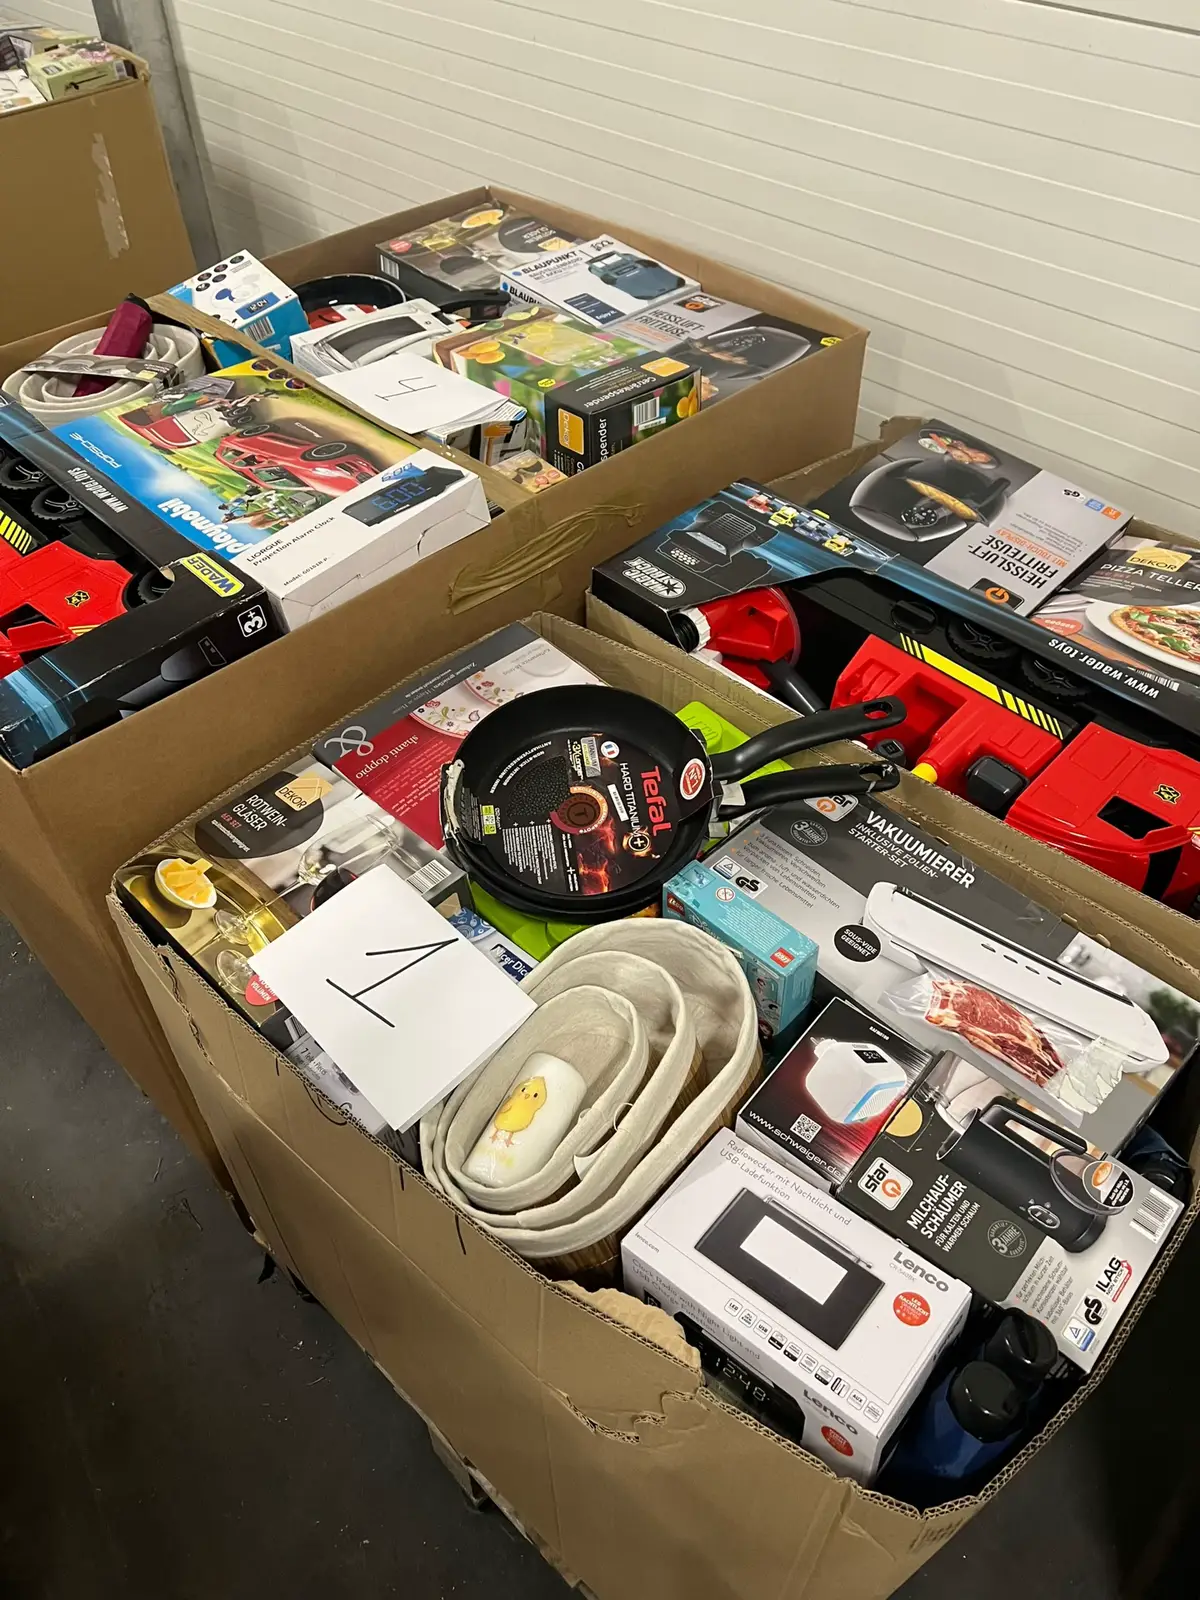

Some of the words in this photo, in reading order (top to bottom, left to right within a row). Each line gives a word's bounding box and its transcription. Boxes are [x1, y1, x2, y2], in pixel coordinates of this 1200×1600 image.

[522, 250, 578, 275] BLAUPUNKT
[634, 315, 691, 336] FRITTEUSE
[648, 309, 706, 332] HEISSLUFT-
[375, 376, 437, 401] 4
[69, 431, 122, 469] PORSCHE
[67, 466, 129, 514] www.wader.toys
[157, 498, 253, 554] playmobil
[246, 538, 283, 563] LIORQUE
[252, 539, 292, 567] Projection
[292, 526, 315, 545] Alarm
[315, 515, 336, 532] Clock
[981, 533, 1060, 578] FRITTEUSE
[186, 557, 234, 593] WADER
[624, 556, 678, 584] TRUCK
[968, 543, 1047, 590] HEISSLUFT-
[1100, 563, 1144, 577] PIZZA
[1149, 571, 1200, 592] TELLER
[1129, 557, 1178, 571] DEKOR
[624, 568, 669, 597] MAGIC
[243, 610, 265, 636] 3+
[1048, 637, 1160, 700] www.wader.toys
[388, 733, 419, 758] shanti
[355, 752, 391, 780] doppio
[619, 762, 633, 791] HARD
[246, 794, 288, 827] ROTWEIN-
[278, 786, 308, 808] DEKOR
[640, 765, 672, 836] Tefal
[232, 803, 268, 832] GLÄSER
[624, 789, 642, 838] TITANIUM
[794, 821, 807, 831] 3
[803, 827, 823, 844] JAHRE
[848, 827, 909, 869] STARTER-SET
[855, 822, 904, 856] INKLUSIVE
[902, 853, 939, 879] FOLIEN-
[866, 810, 975, 889] VAKUUMIERER
[735, 876, 760, 892] GS
[770, 865, 781, 875] von
[780, 872, 817, 901] Lebensmitteln
[779, 880, 813, 909] Lebensmittel
[791, 871, 803, 882] und
[801, 878, 840, 909] wasserdichten
[840, 933, 872, 959] GEEIGNET
[843, 927, 878, 956] SOUS-VIDE
[493, 946, 515, 968] Nicer
[749, 1110, 842, 1178] www.schwaiger.de
[719, 1148, 791, 1201] USB-Ladefunktion
[727, 1139, 777, 1179] Radiowecker
[775, 1173, 791, 1186] mit
[792, 1181, 834, 1216] Nachtlicht
[834, 1210, 853, 1226] und
[864, 1162, 889, 1193] star
[906, 1173, 950, 1230] MILCHAUF-
[920, 1180, 968, 1239] SCHÄUMER
[960, 1202, 981, 1229] SCHAUM
[934, 1231, 947, 1248] FÜR
[944, 1212, 962, 1236] KALTEN
[958, 1199, 971, 1215] UND
[635, 1231, 661, 1254] lenco.com
[991, 1237, 1008, 1254] 3
[1002, 1226, 1021, 1246] JAHRE
[893, 1250, 950, 1292] Lenco
[1095, 1257, 1122, 1293] ILAG
[1105, 1284, 1115, 1295] NON
[729, 1302, 739, 1311] LED
[1084, 1296, 1103, 1325] GS
[679, 1297, 696, 1311] with
[722, 1327, 744, 1348] Light
[744, 1345, 761, 1361] and
[758, 1323, 768, 1333] USB
[803, 1388, 858, 1436] Lenco
[852, 1394, 864, 1404] AUX
